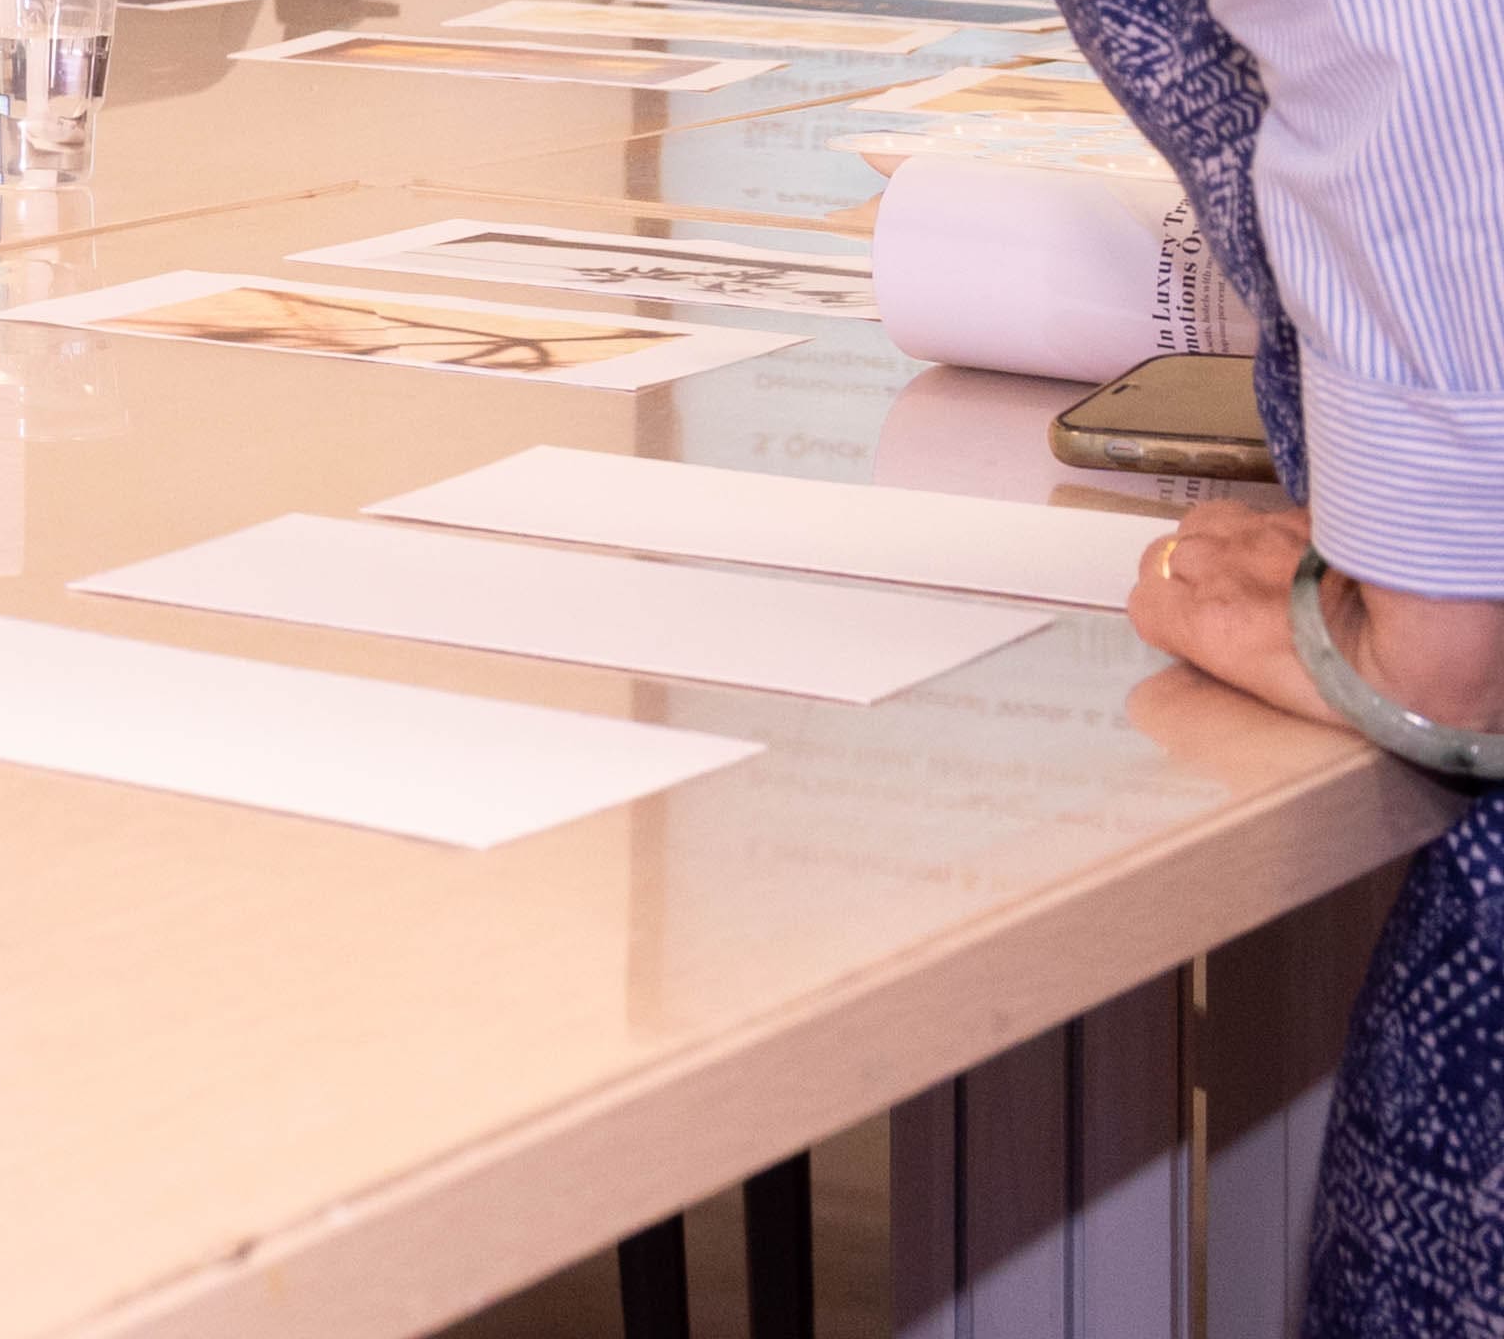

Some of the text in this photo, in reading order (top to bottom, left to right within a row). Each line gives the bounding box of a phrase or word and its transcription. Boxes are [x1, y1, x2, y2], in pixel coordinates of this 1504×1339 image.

[1152, 233, 1181, 322] Luxury
[1202, 269, 1212, 292] with
[1157, 328, 1177, 351] In
